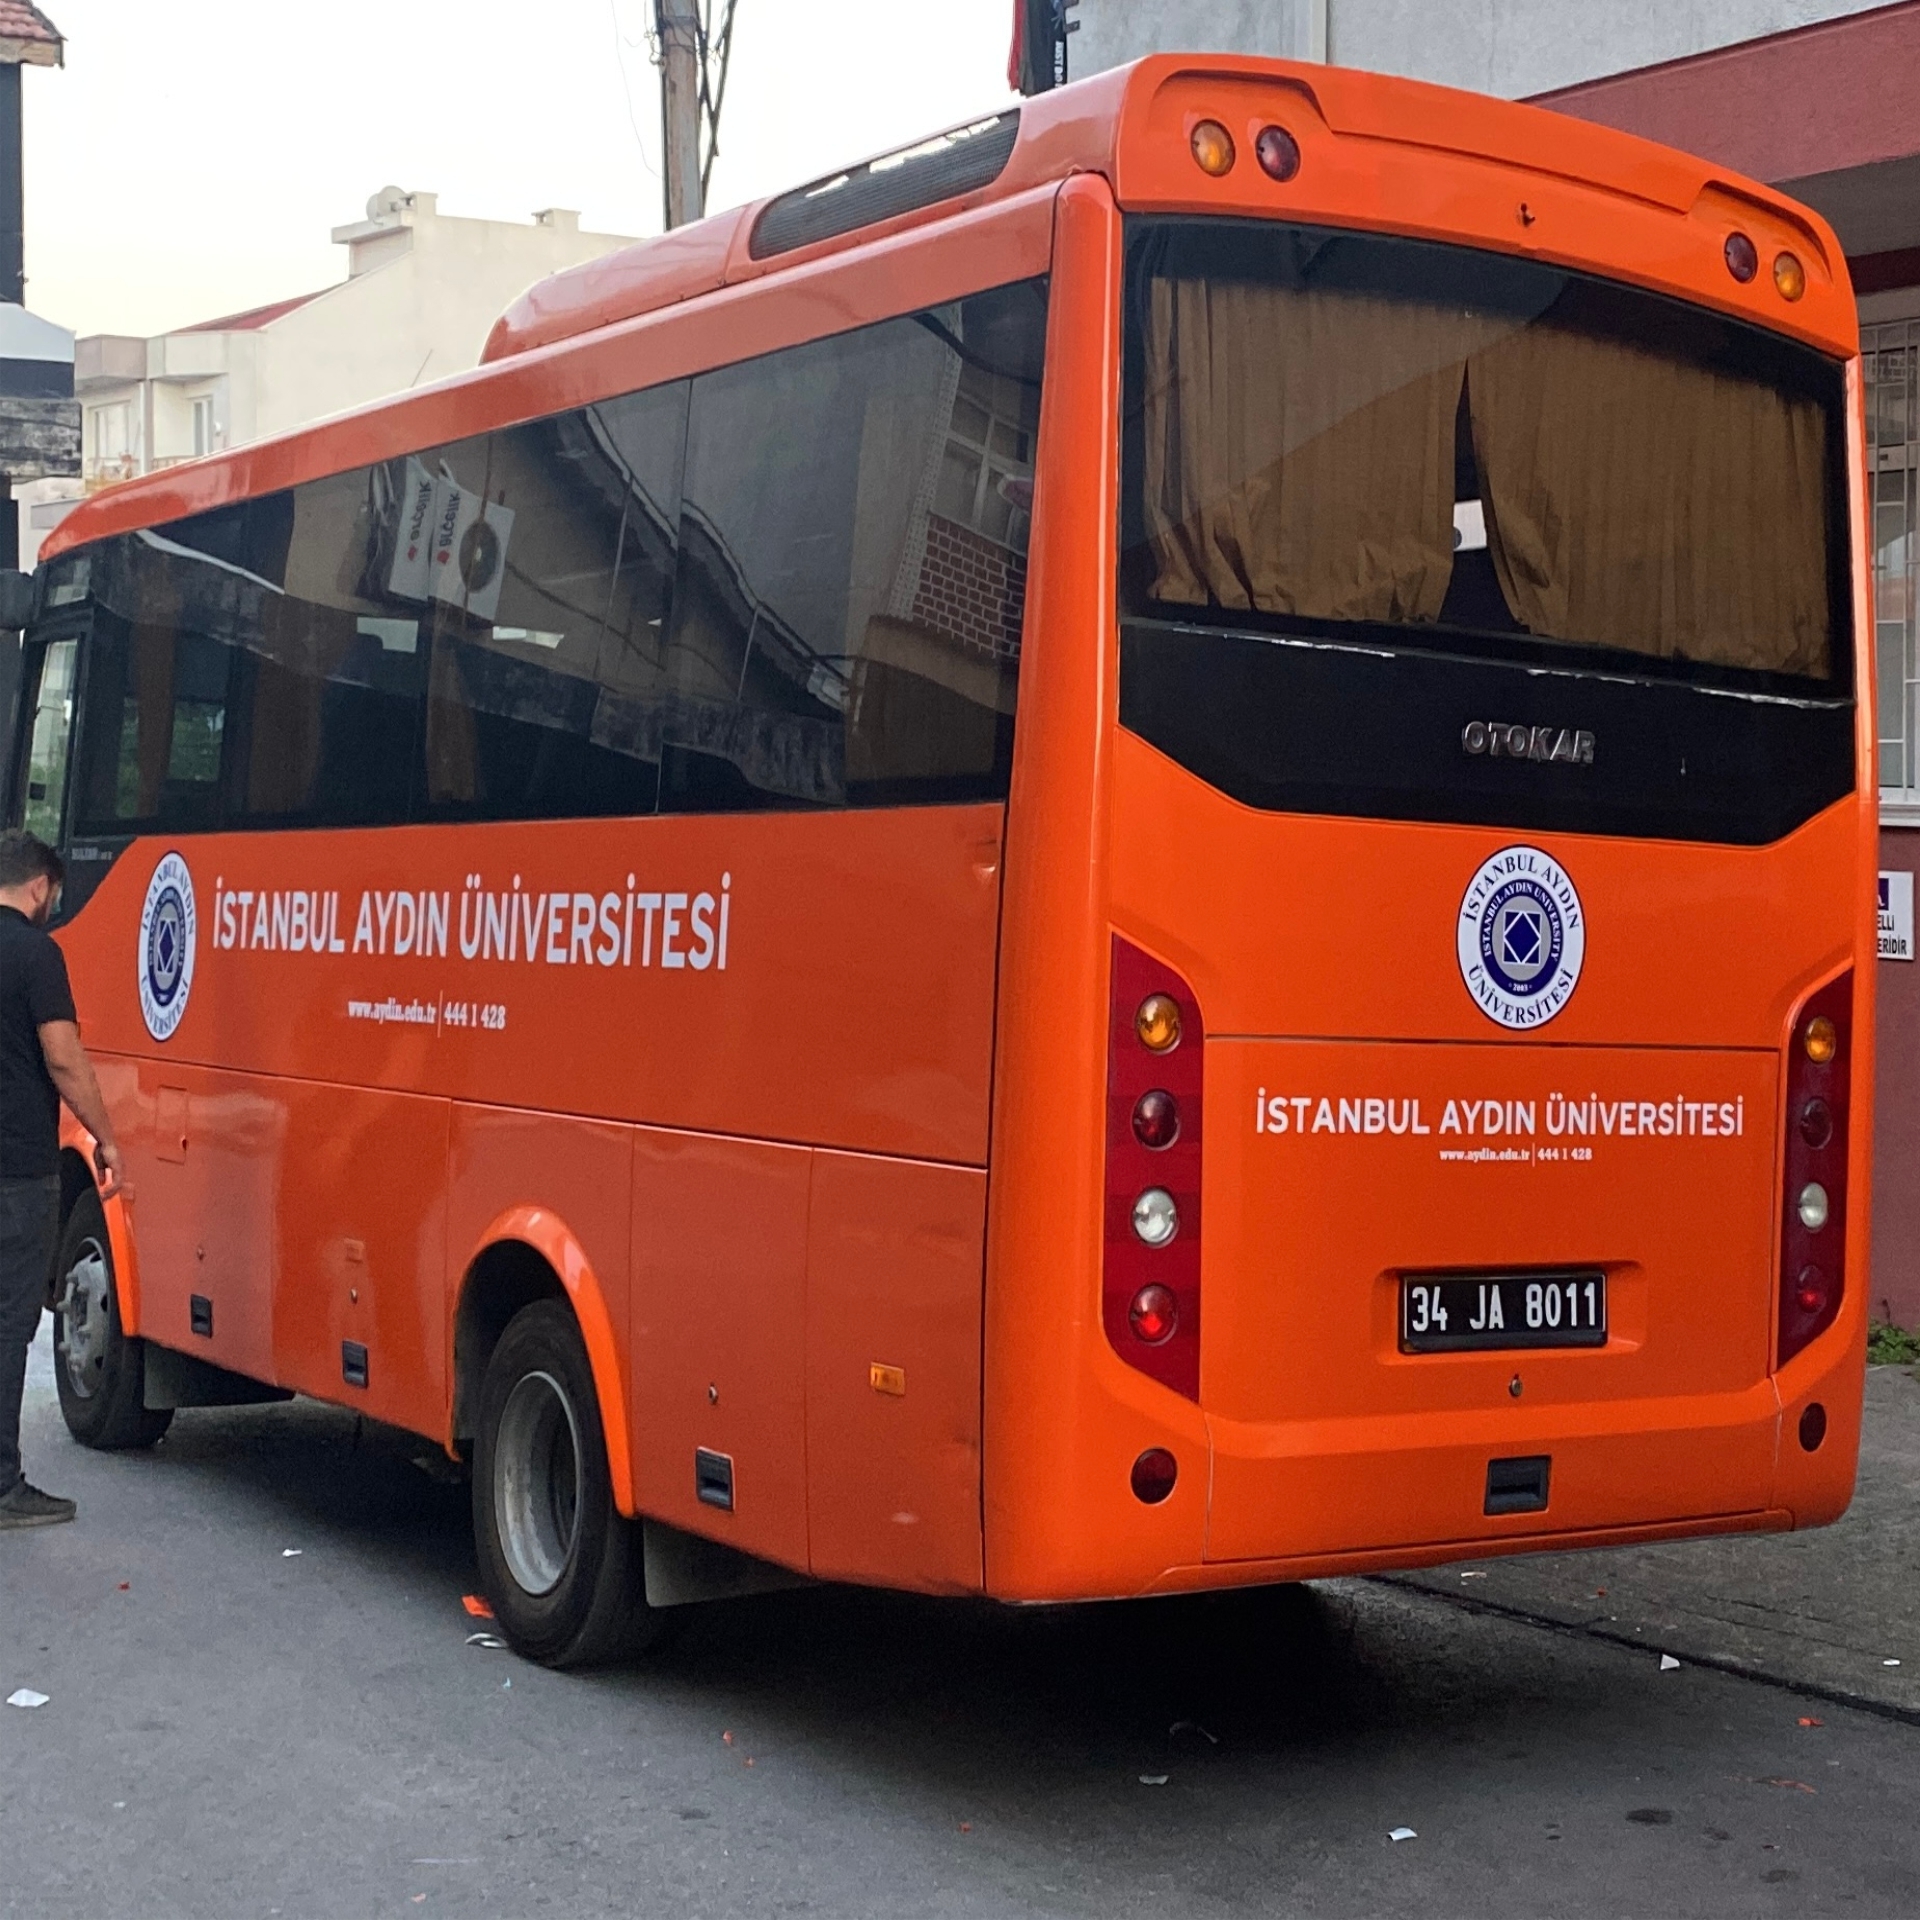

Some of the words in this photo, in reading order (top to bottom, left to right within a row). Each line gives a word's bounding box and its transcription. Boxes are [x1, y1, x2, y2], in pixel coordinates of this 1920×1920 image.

[1462, 721, 1596, 763] OTOKAR
[1463, 854, 1538, 922] İSTANBUL
[1542, 865, 1580, 930] AYDIN
[213, 875, 345, 953] İSTANBUL
[352, 890, 450, 957] AYDIN
[459, 871, 731, 970] ÜNİVERSİTESİ
[348, 997, 437, 1025] www.aydin.edu.tr
[444, 1001, 468, 1027] 444
[480, 1004, 506, 1030] 428
[1468, 964, 1574, 1024] ÜNİVERSİTESİ
[1256, 1086, 1431, 1135] İSTANBUL
[1438, 1099, 1536, 1135] AYDIN
[1545, 1092, 1744, 1136] ÜNİVERSİTESİ
[1439, 1147, 1530, 1163] www.aydin.edu.tr
[1537, 1147, 1559, 1161] 444
[1571, 1147, 1593, 1161] 428
[1412, 1286, 1448, 1332] 34
[1469, 1284, 1504, 1330] JA
[1526, 1282, 1595, 1328] 8011
